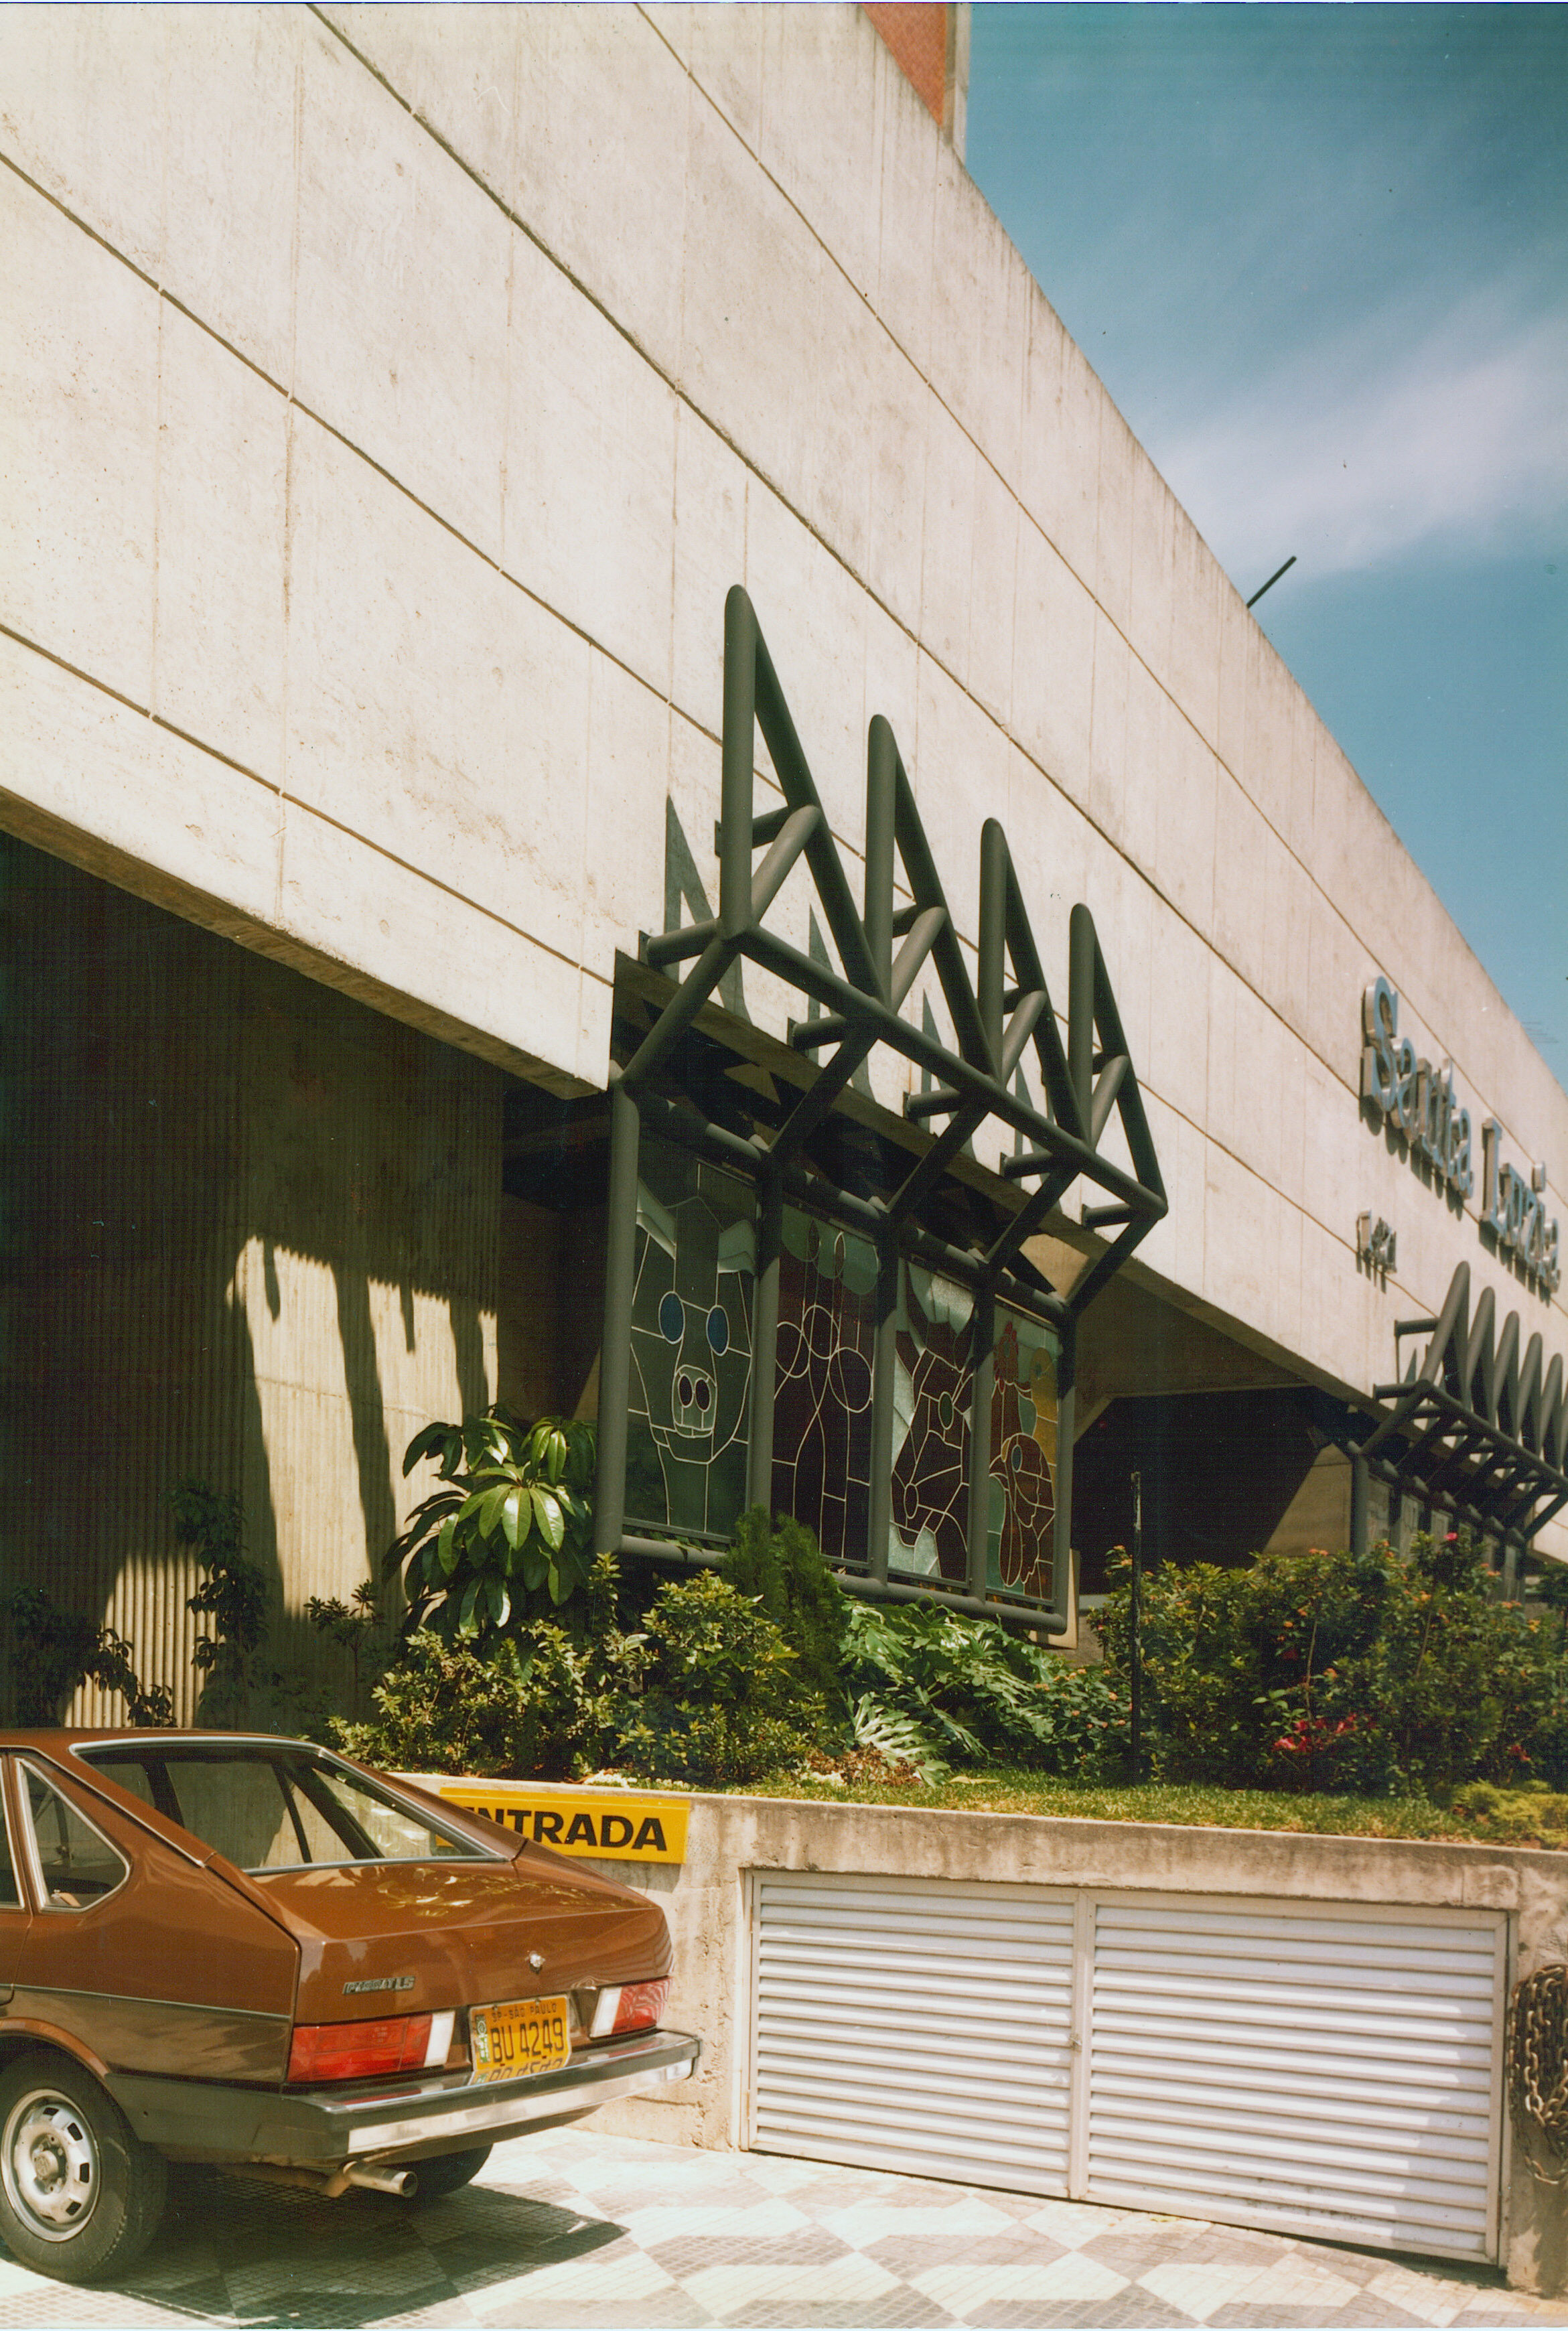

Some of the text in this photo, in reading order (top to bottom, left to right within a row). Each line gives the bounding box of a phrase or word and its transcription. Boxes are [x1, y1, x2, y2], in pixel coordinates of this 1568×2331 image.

[1361, 976, 1473, 1199] Santa
[464, 1807, 668, 1851] TRADA
[395, 1975, 415, 1991] LS
[530, 2002, 557, 2015] PAULO
[490, 2018, 564, 2062] BU 4249
